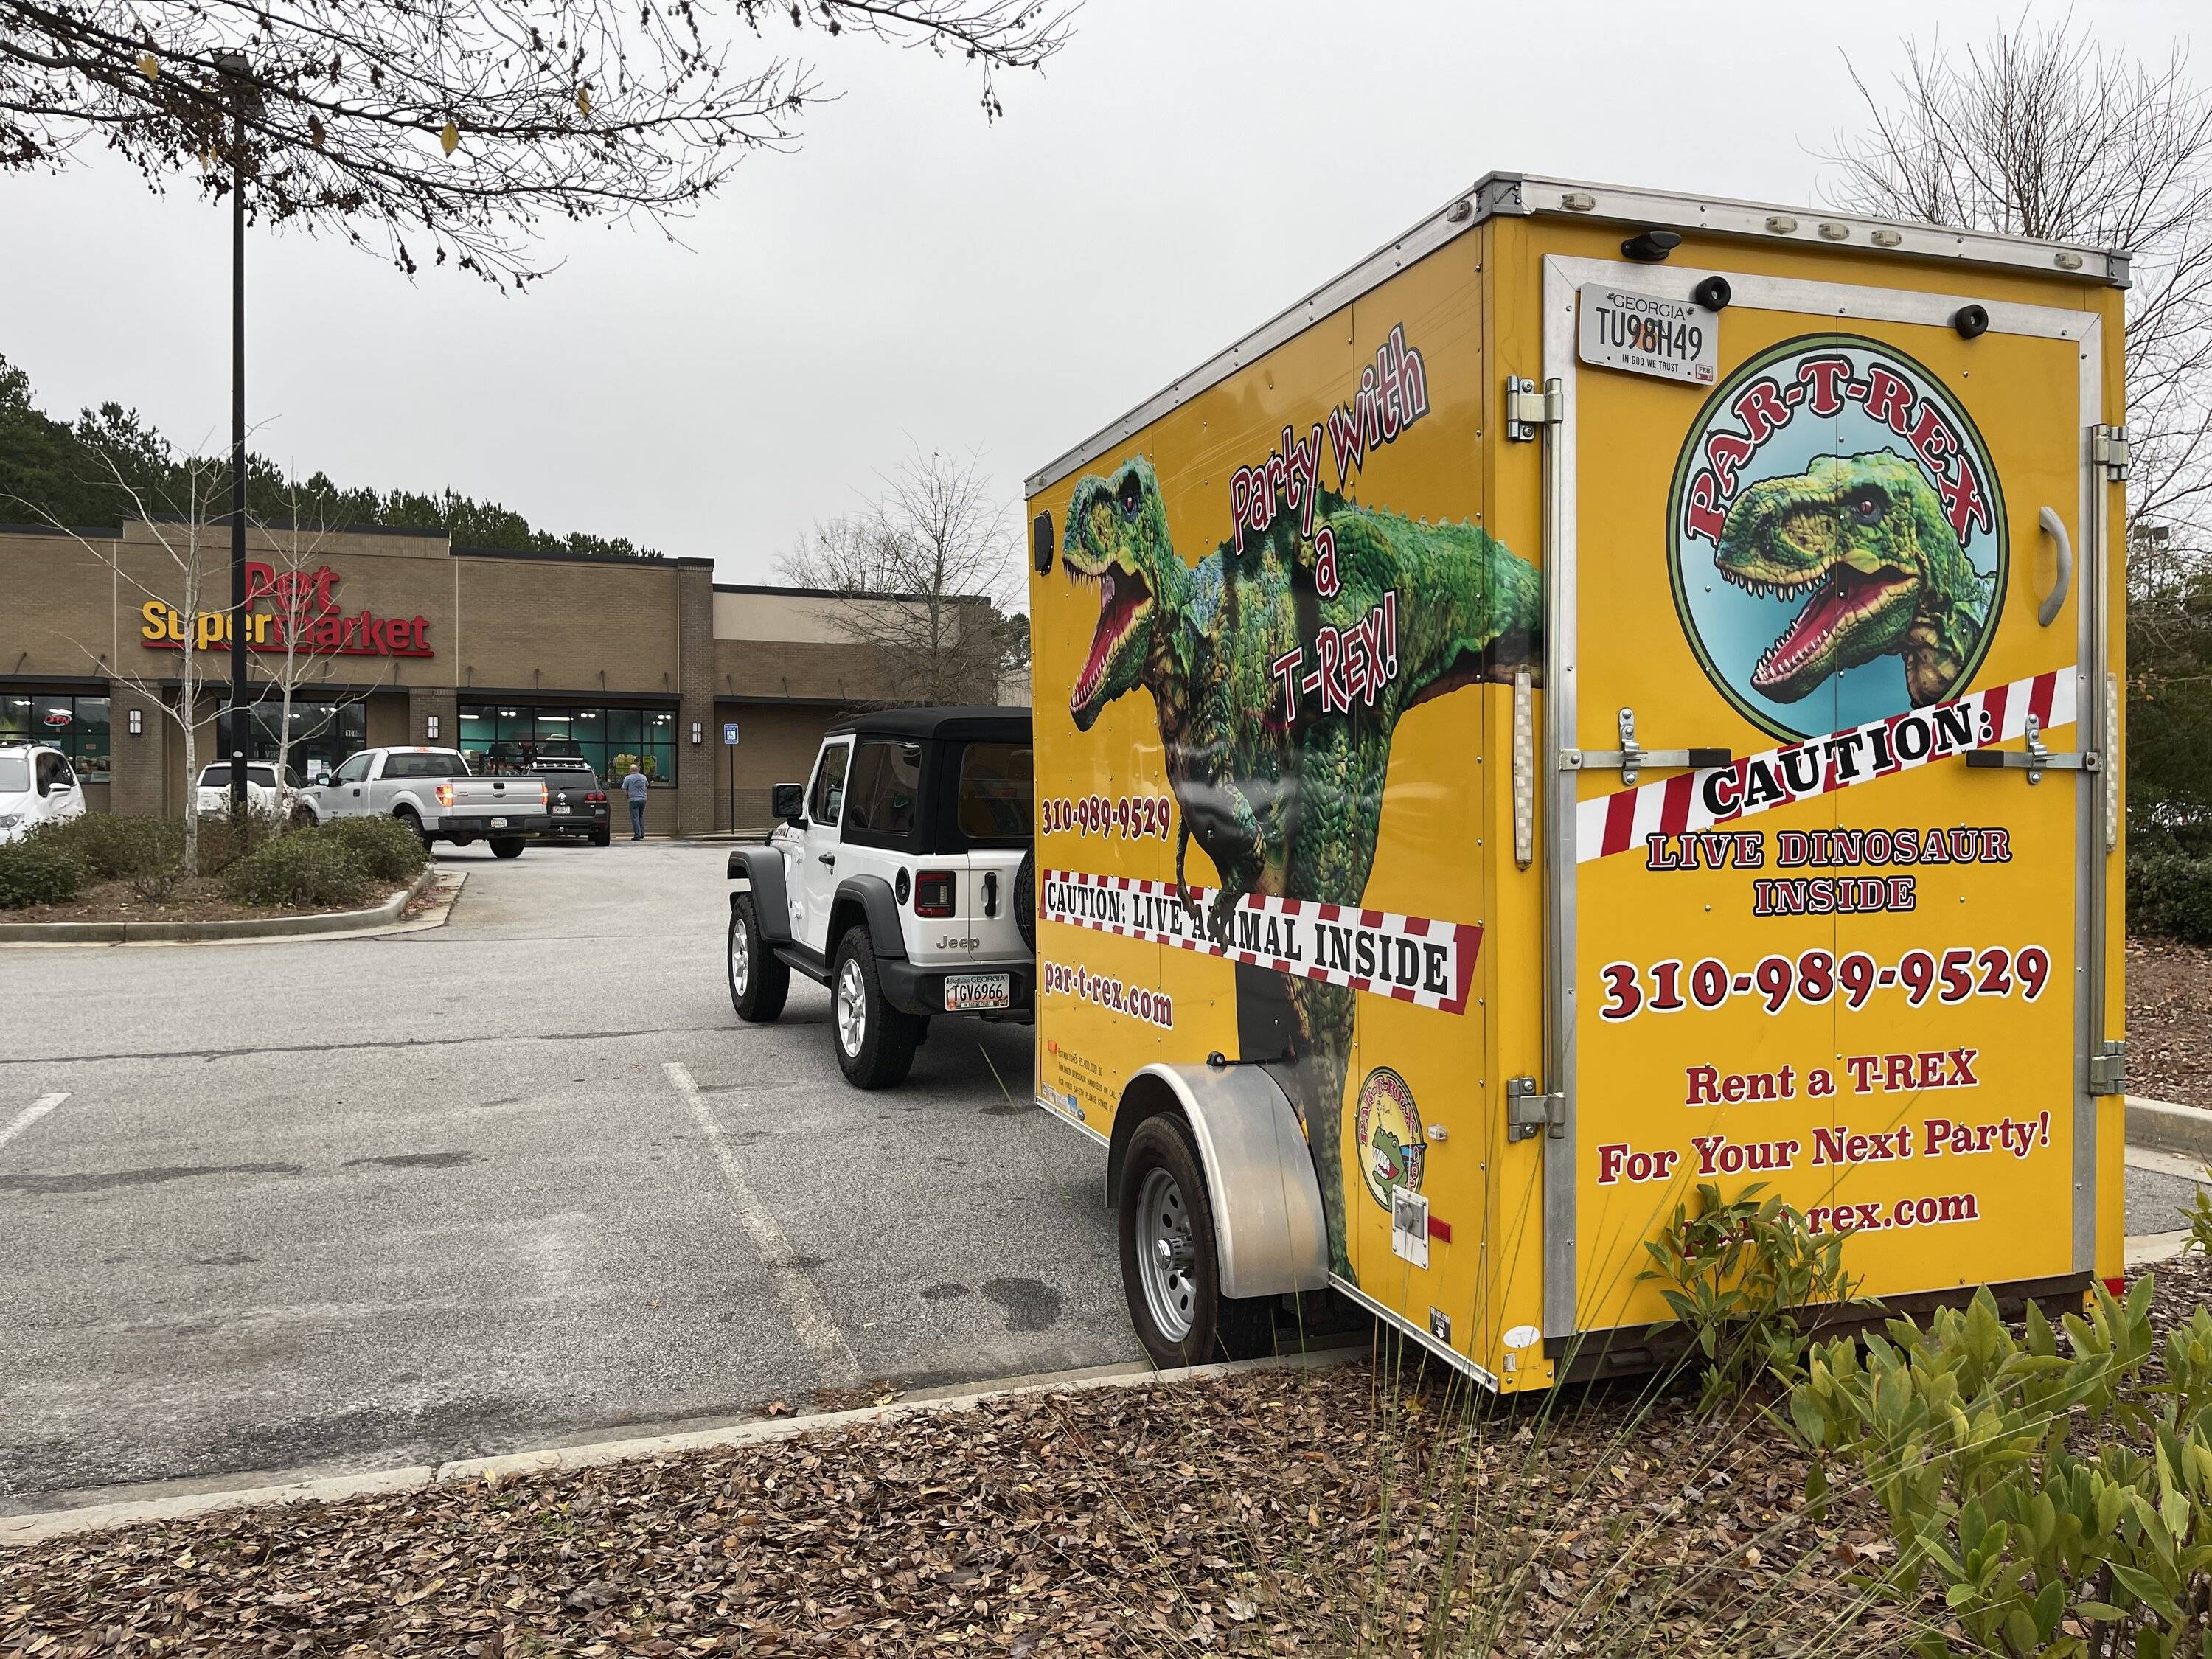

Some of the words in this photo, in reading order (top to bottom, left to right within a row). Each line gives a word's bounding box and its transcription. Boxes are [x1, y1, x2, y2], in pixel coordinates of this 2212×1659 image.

[1595, 307, 1703, 361] TU98H49
[1613, 294, 1686, 321] GEORGIA
[1622, 354, 1630, 364] IN
[1632, 355, 1644, 366] GOD
[1646, 358, 1657, 369] WE
[1659, 361, 1679, 373] TRUST
[1231, 425, 1322, 559] Party
[1329, 324, 1429, 489] with
[1686, 355, 1993, 546] PAR-T-REX
[245, 561, 341, 615] Pet
[1315, 526, 1338, 600] a
[1273, 591, 1399, 723] T-REX!
[45, 715, 70, 725] OPEN
[1702, 701, 1994, 818] CAUTION:
[1042, 794, 1172, 841] 310-989-9529
[1647, 832, 1764, 871] LIVE
[1777, 828, 2013, 869] DINOSAUR
[1753, 876, 1916, 916] INSIDE
[936, 934, 980, 951] Jeep
[1046, 881, 1127, 924] CAUTION:
[1132, 894, 1183, 933] LIVE
[1314, 923, 1449, 995] INSIDE
[952, 983, 1004, 1002] TGV6966
[970, 975, 1006, 984] GEORGIA
[1043, 961, 1174, 1029] par-t-rex.com
[1599, 945, 2051, 1022] 310-989-9529
[1685, 1063, 1795, 1105] Rent
[1807, 1069, 1835, 1097] a
[1848, 1049, 1979, 1093] T-REX
[1597, 1144, 1678, 1184] For
[1691, 1135, 1800, 1177] Your
[1812, 1124, 1913, 1166] Next
[1924, 1111, 2051, 1160] Party!
[1683, 1193, 1979, 1259] rex.com
